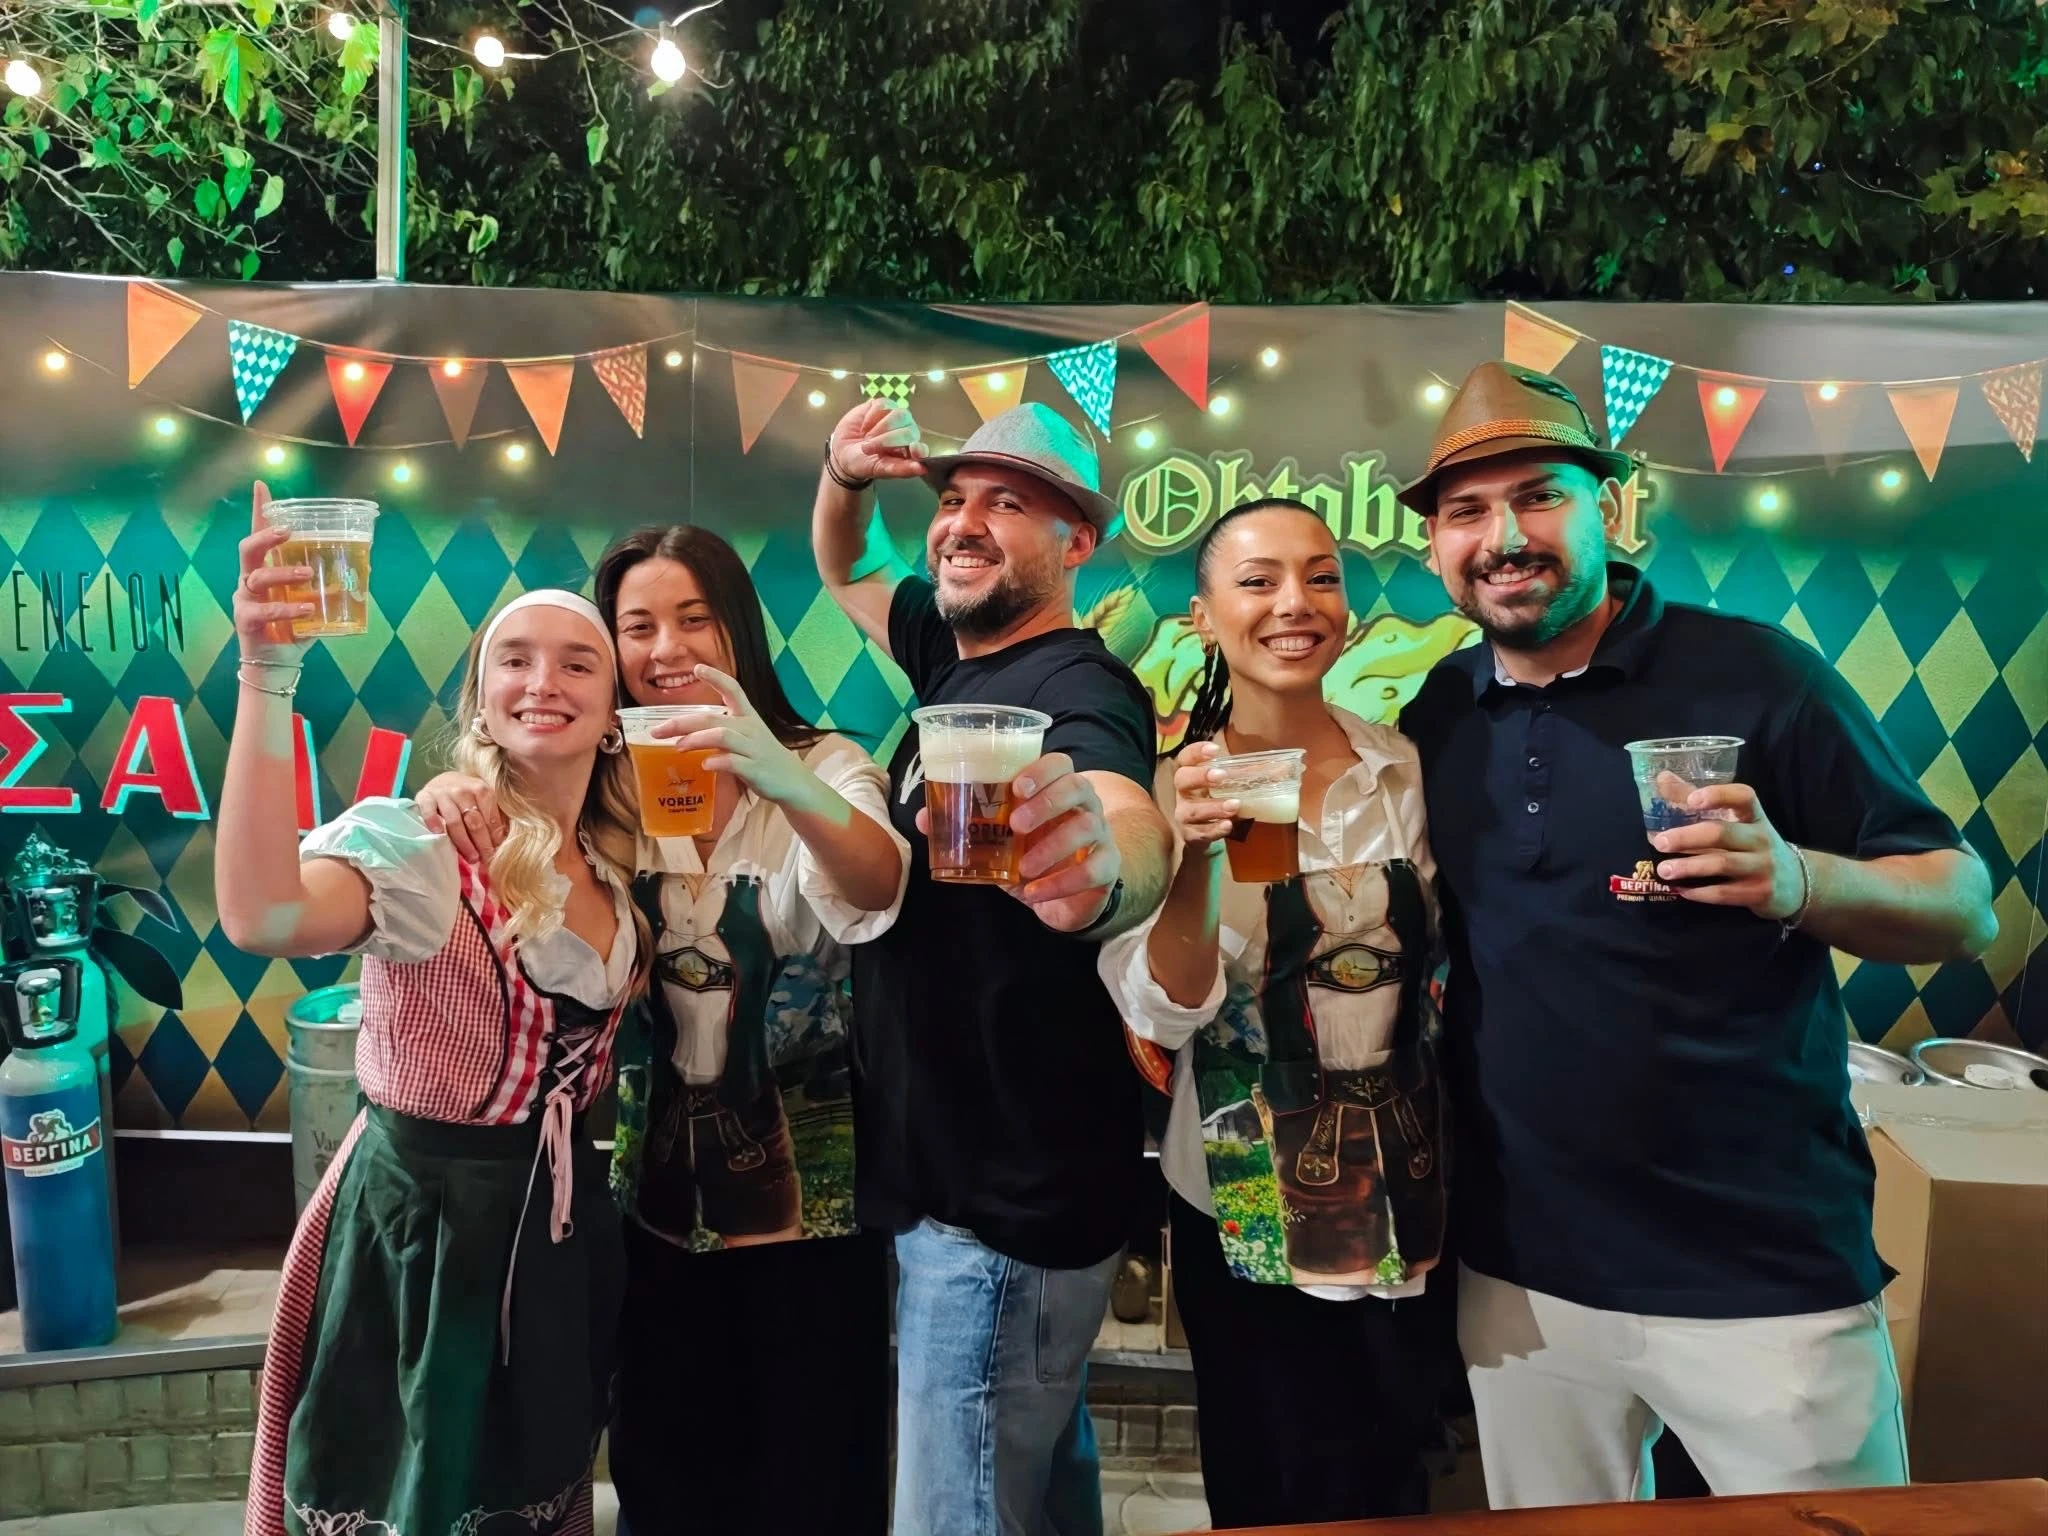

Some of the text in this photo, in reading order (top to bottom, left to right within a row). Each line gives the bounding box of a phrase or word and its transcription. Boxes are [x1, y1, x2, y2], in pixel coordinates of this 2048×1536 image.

[658, 795, 704, 807] VOREIA
[1620, 879, 1671, 892] ΒΕΡΓΙΝΑ
[12, 1133, 93, 1163] ΒΕΡΓΙΝΑ
